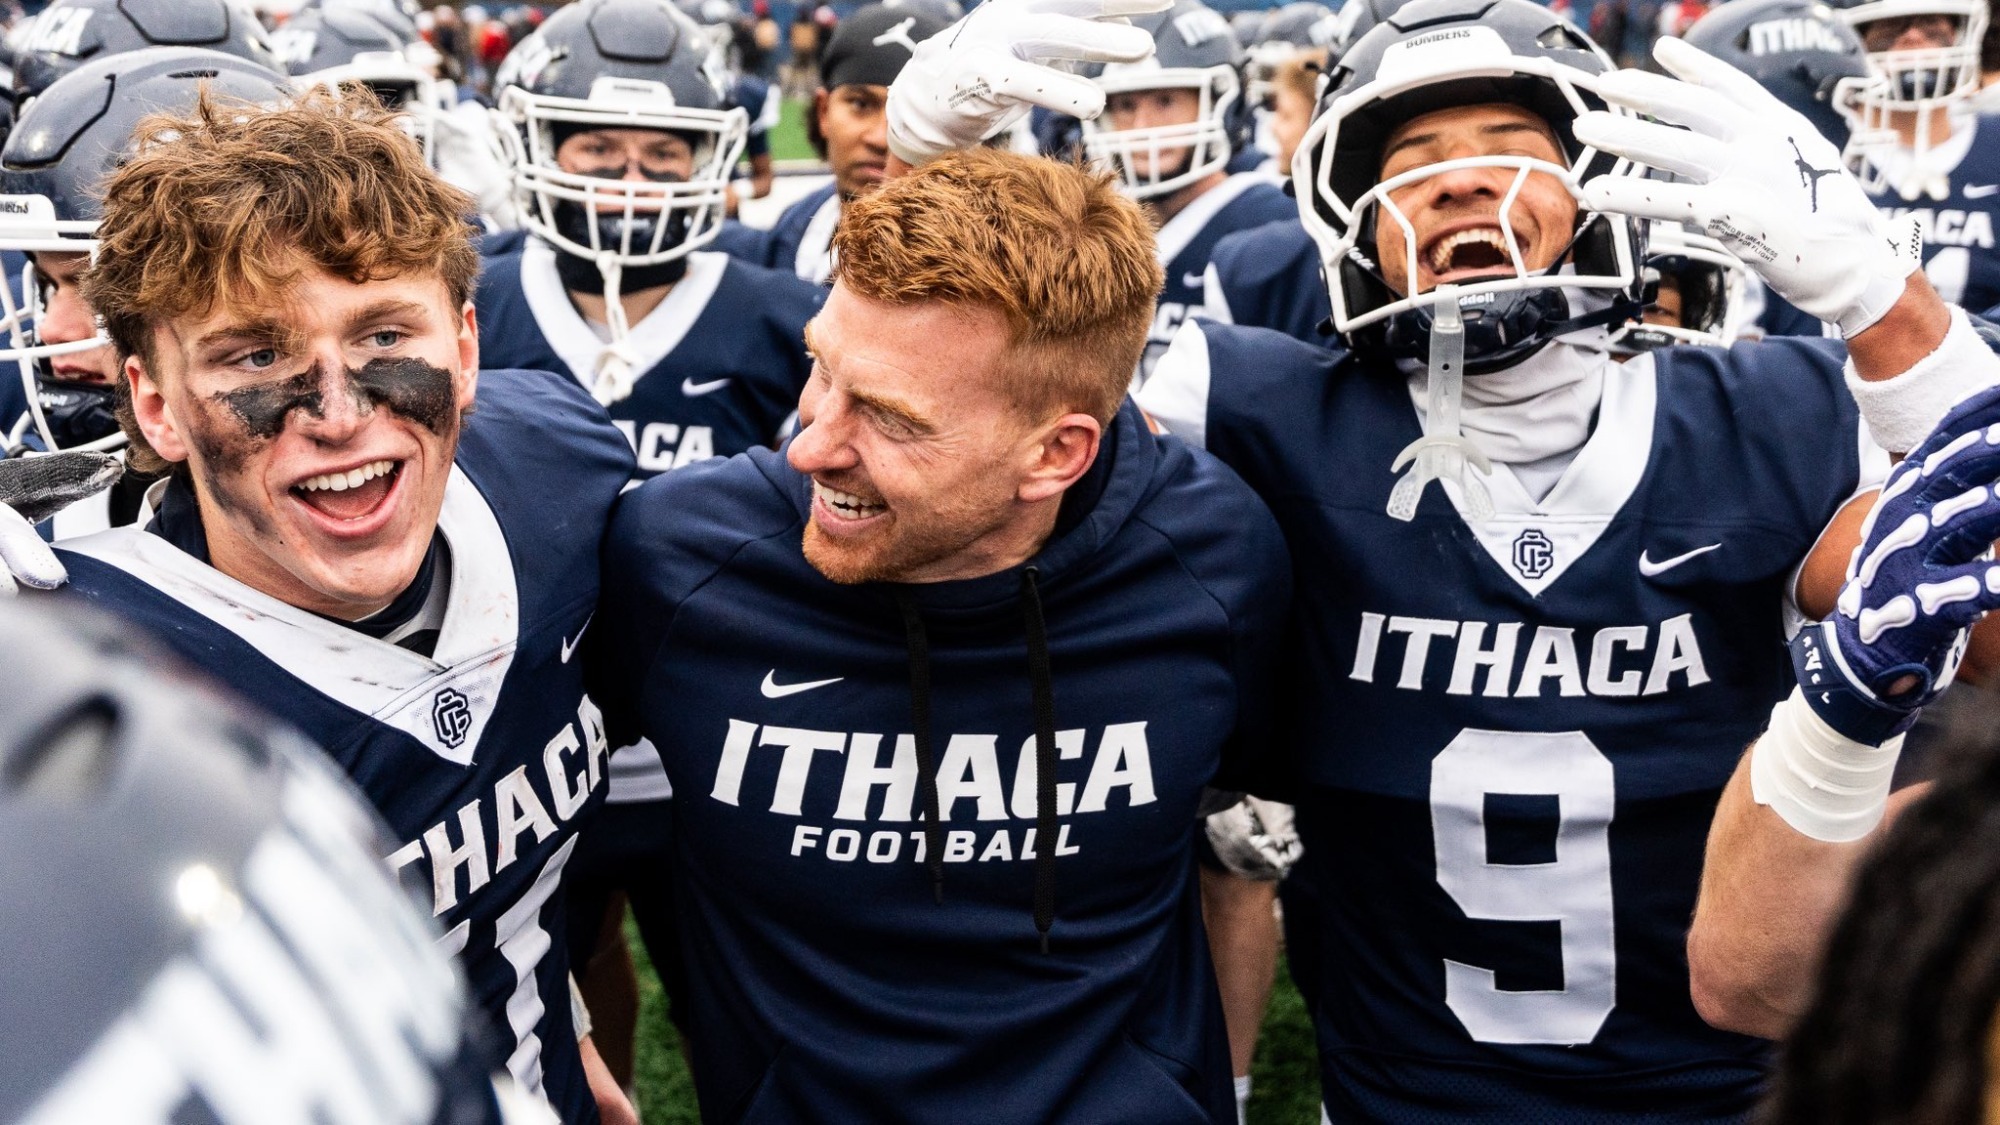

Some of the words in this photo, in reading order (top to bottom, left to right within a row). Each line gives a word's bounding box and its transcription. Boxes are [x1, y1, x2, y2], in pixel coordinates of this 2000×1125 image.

[612, 420, 714, 470] CA
[1349, 611, 1711, 699] ITHACA
[709, 718, 1158, 822] ITHACA
[790, 823, 1080, 864] FOOTBALL
[1429, 726, 1617, 1045] 9
